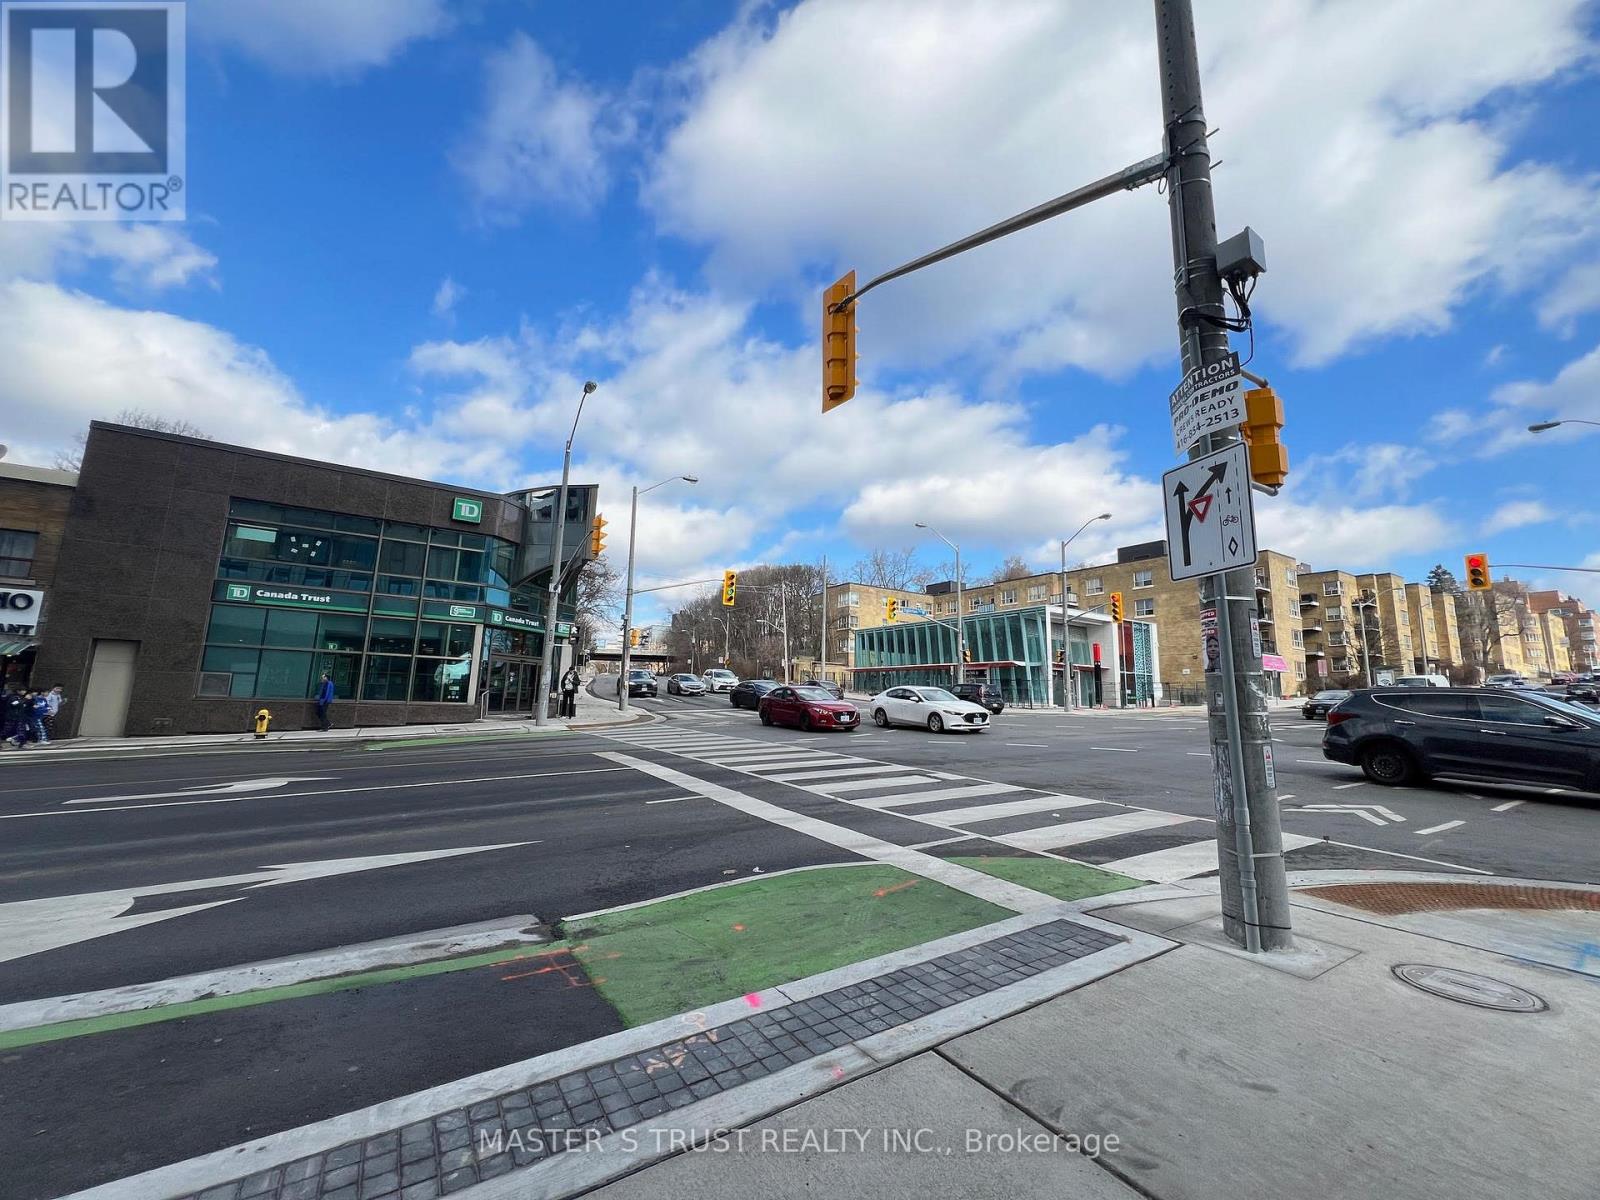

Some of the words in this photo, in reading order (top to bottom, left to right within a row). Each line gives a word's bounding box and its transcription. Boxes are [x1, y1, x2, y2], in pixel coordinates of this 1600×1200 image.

[1172, 357, 1234, 407] ATTENTION
[1195, 396, 1235, 417] READY
[1176, 408, 1240, 450] 416-854-2513
[457, 502, 480, 518] TD
[231, 587, 248, 598] TD
[256, 589, 299, 600] Canada
[301, 593, 332, 603] Trust
[505, 615, 525, 624] Canada
